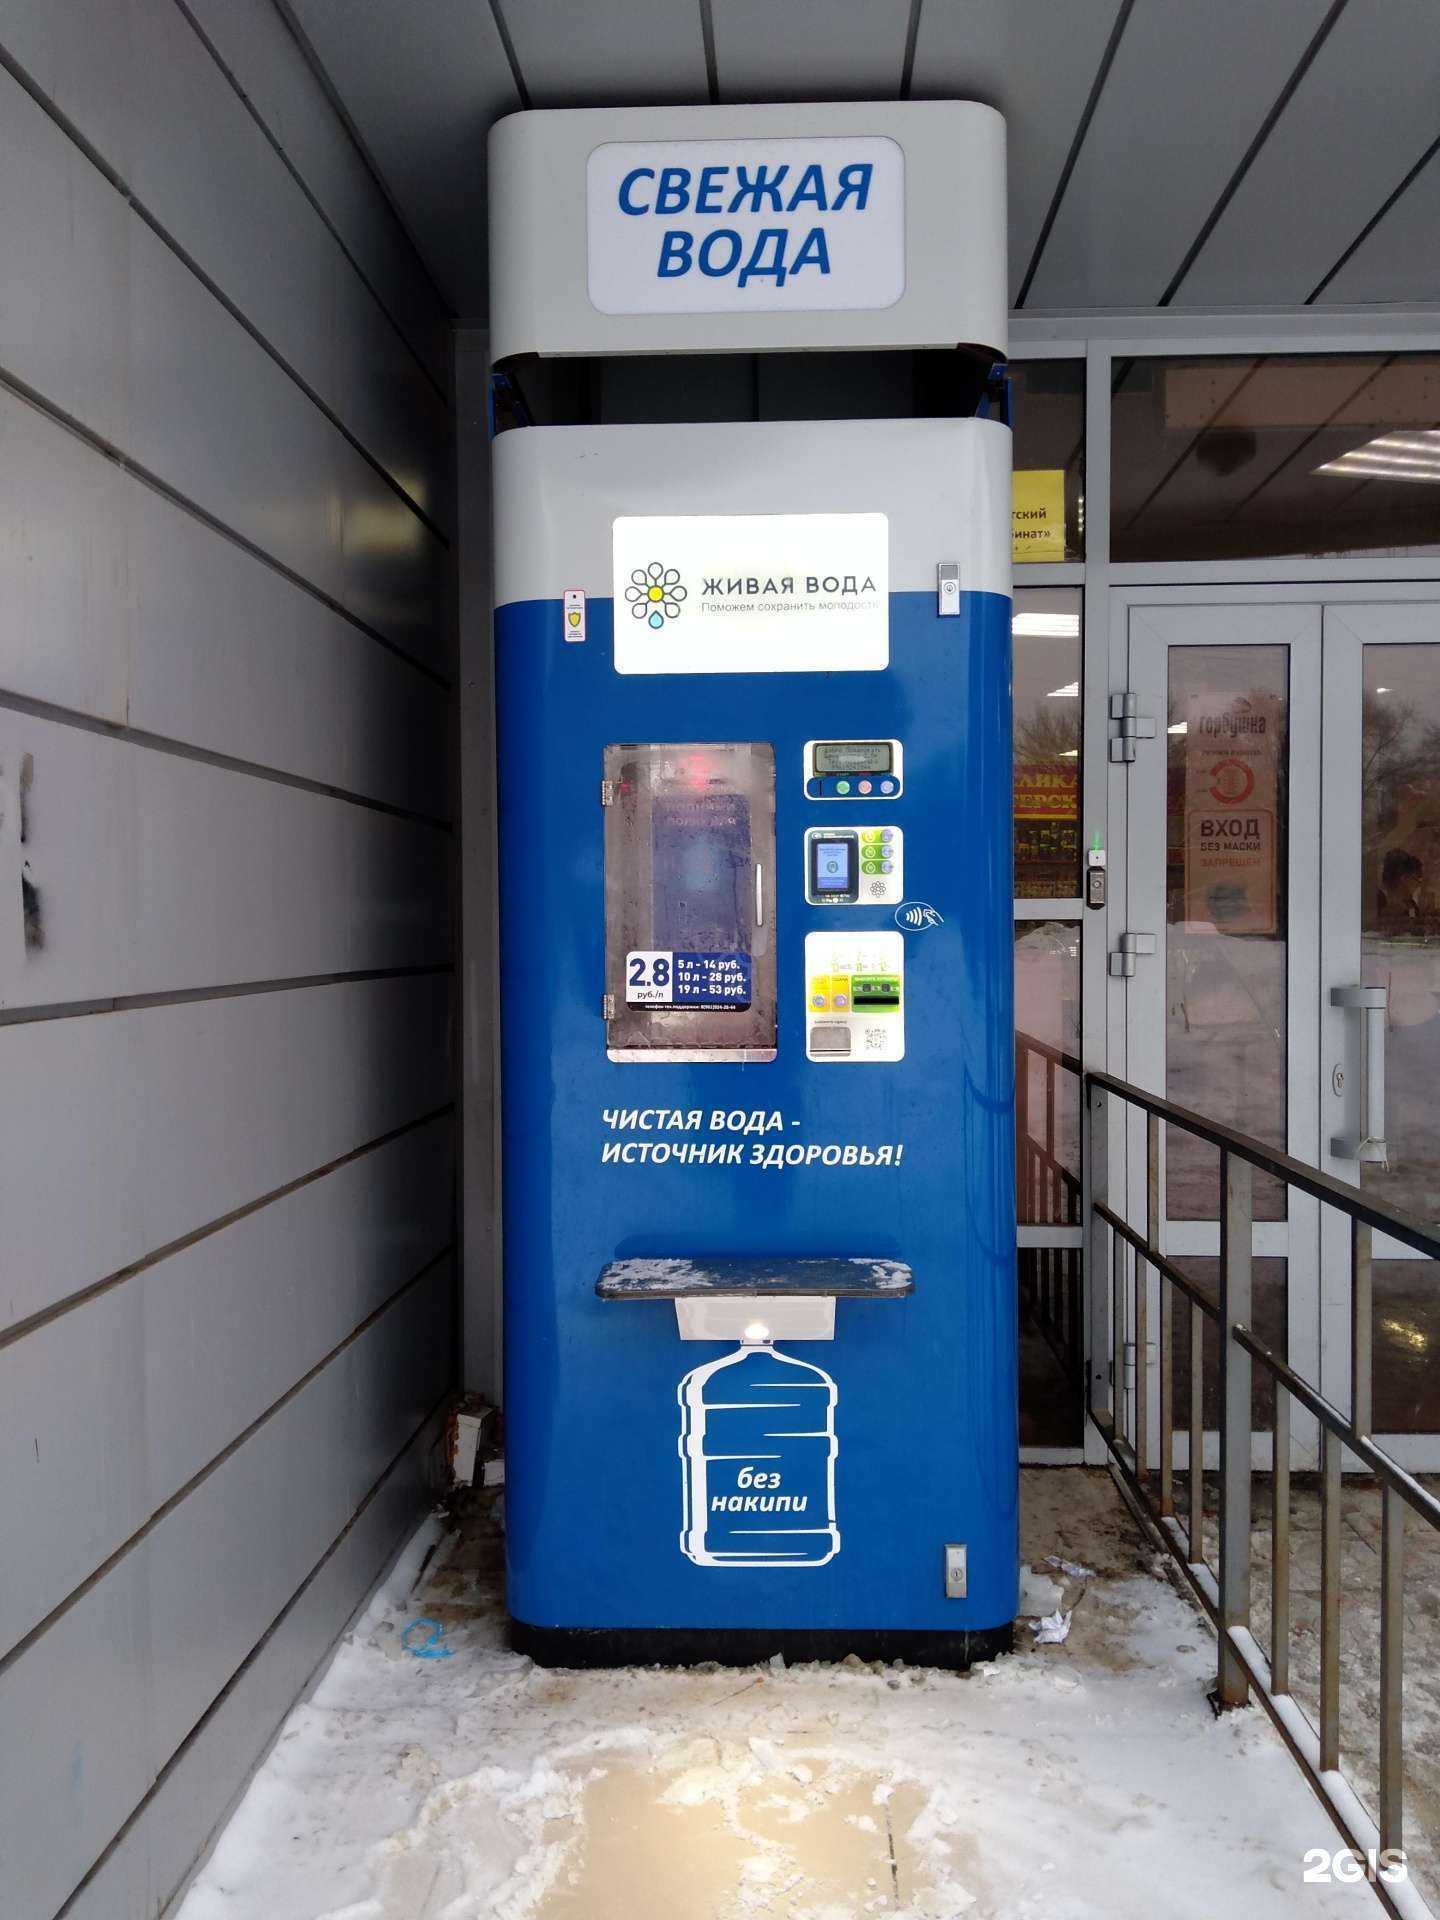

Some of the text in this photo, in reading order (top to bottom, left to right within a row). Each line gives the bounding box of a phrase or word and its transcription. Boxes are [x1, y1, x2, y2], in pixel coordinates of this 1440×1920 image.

[618, 163, 874, 216] СВЕЖАЯ
[656, 227, 831, 288] ВОДА
[702, 576, 877, 596] ЖИВАЯ ВОДА
[701, 602, 755, 613] Поможем
[757, 602, 816, 613] сохранить
[1199, 711, 1267, 739] горбушка
[1200, 818, 1261, 840] ВХОД
[1200, 841, 1262, 852] БЕЗ МАСКИ
[629, 958, 670, 987] 2.8
[678, 960, 685, 969] 5
[686, 961, 693, 969] л
[703, 959, 717, 969] 14
[718, 960, 740, 971] руб.
[678, 972, 691, 982] 10
[692, 973, 700, 982] л
[709, 972, 722, 982] 28
[724, 973, 746, 983] руб.
[637, 990, 664, 1000] руб./л
[678, 984, 691, 994] 19
[692, 985, 700, 994] л
[709, 984, 722, 994] 53
[724, 985, 746, 996] руб.
[602, 1109, 703, 1131] ЧИСТАЯ
[709, 1109, 784, 1136] ВОДА
[601, 1142, 904, 1170] ИСТОЧНИК ЗДОРОВЬЯ!
[737, 1466, 782, 1489] без
[711, 1496, 808, 1512] накипи
